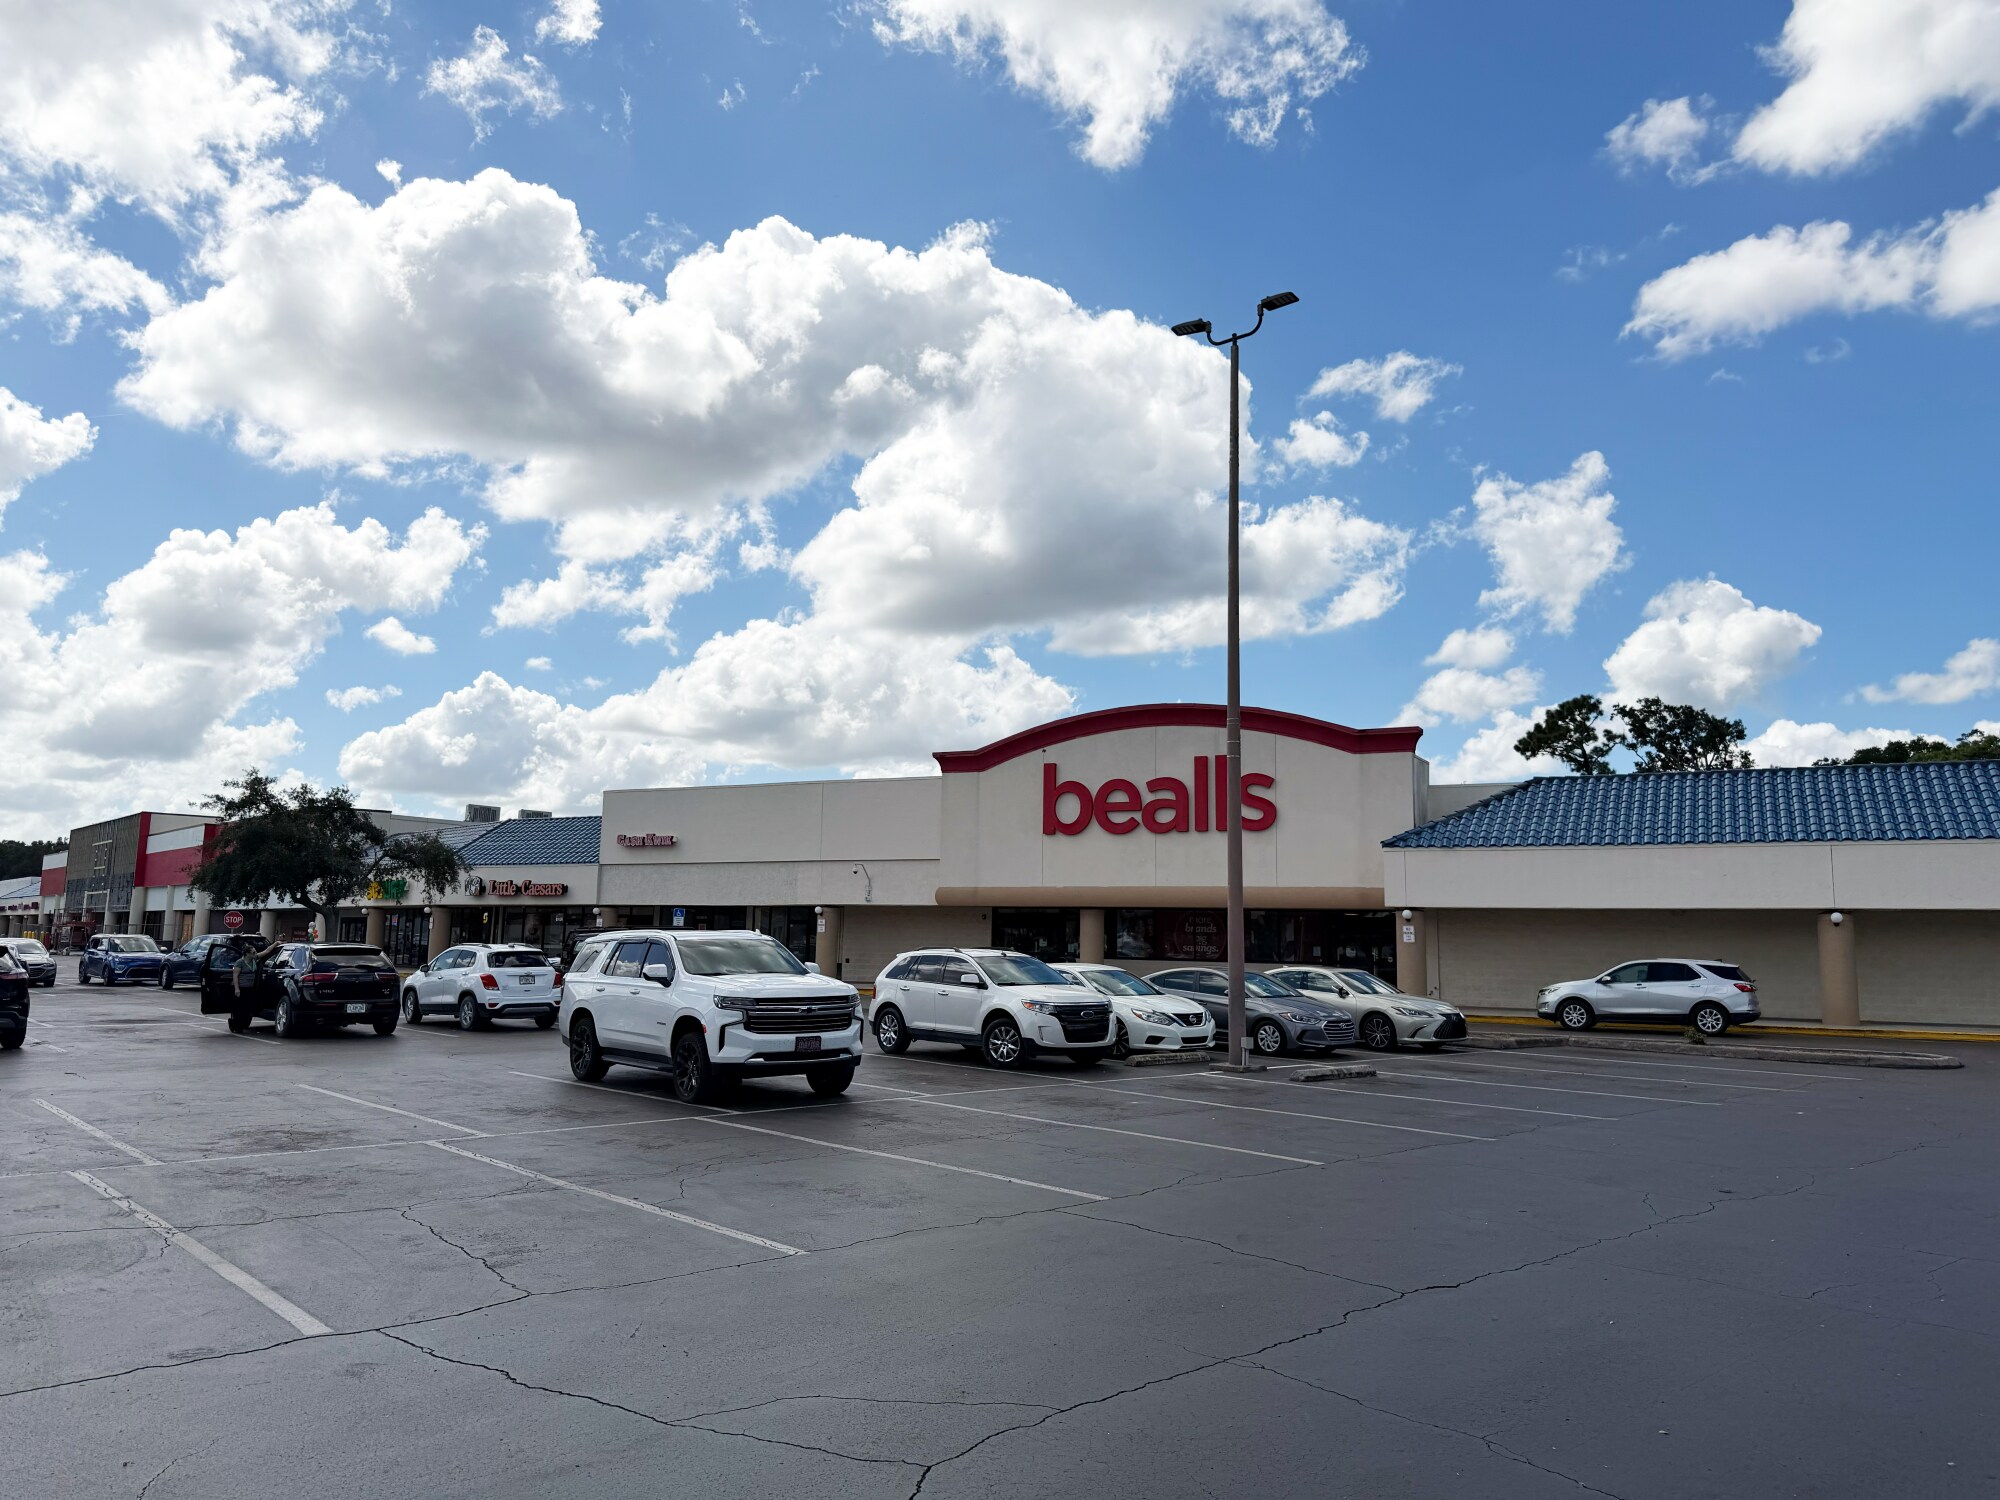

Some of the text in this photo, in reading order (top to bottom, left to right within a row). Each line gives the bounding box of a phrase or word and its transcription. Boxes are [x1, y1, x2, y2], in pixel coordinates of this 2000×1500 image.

[1042, 755, 1277, 836] bealls
[488, 880, 563, 896] Little Caesars
[225, 916, 242, 924] STOP
[1185, 922, 1217, 933] brands
